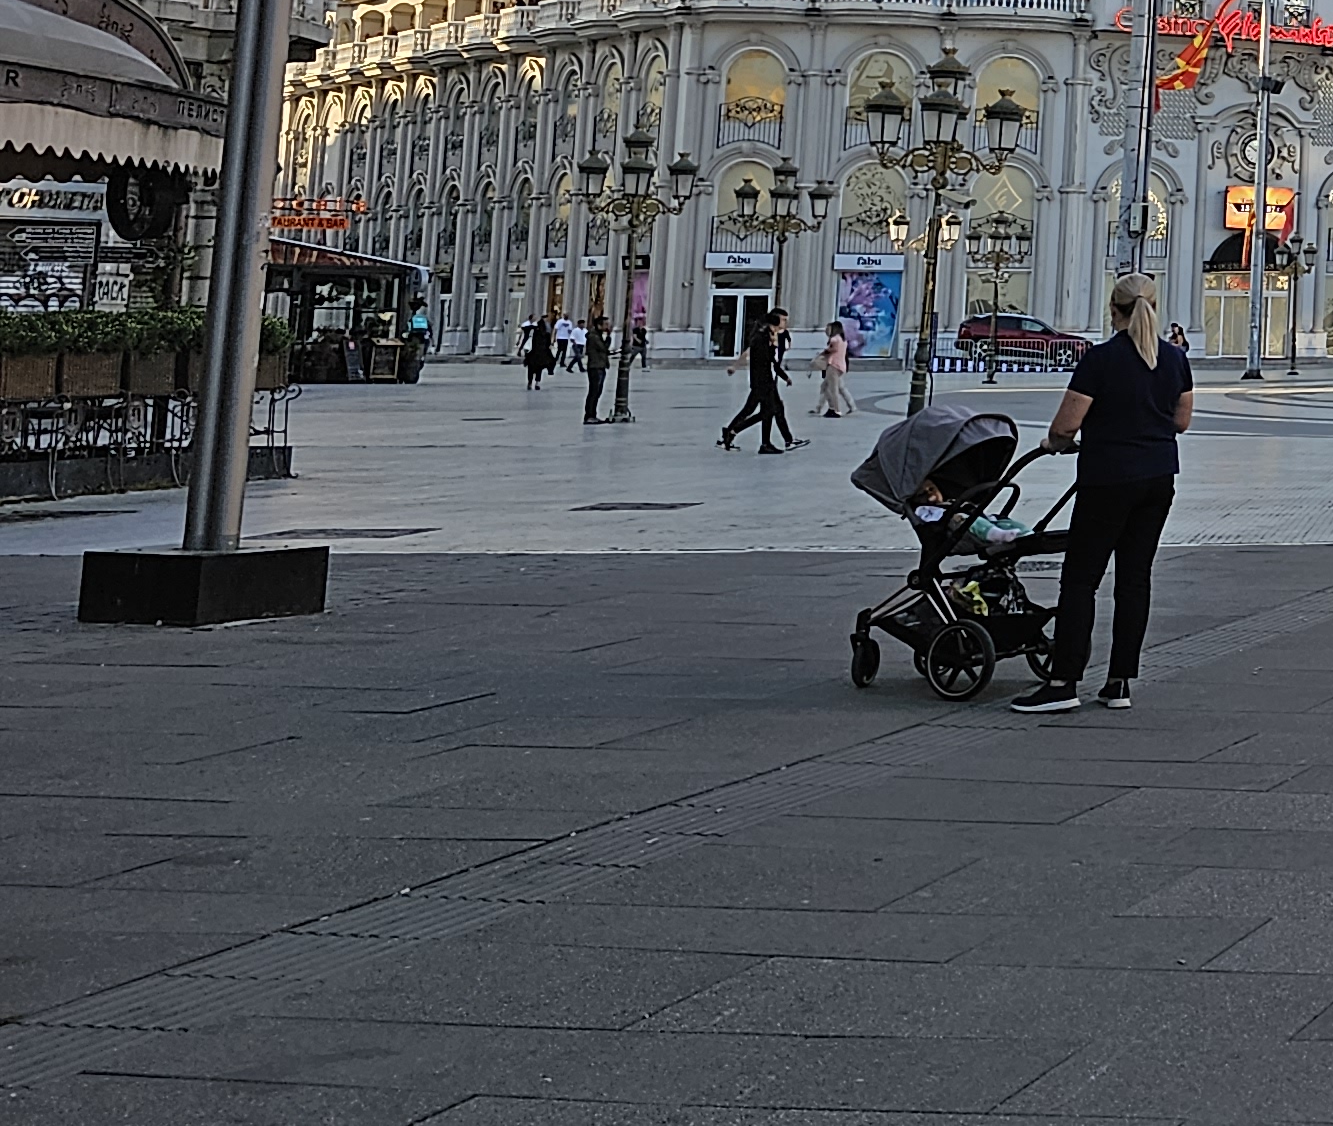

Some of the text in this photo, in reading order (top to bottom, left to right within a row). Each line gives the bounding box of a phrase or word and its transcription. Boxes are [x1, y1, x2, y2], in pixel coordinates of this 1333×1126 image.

[1114, 6, 1212, 36] Csino
[177, 99, 225, 125] ПЕЛИСТ
[271, 216, 316, 228] TAURANT
[326, 218, 346, 229] BAR
[727, 254, 751, 264] fabu
[856, 256, 882, 266] fabu
